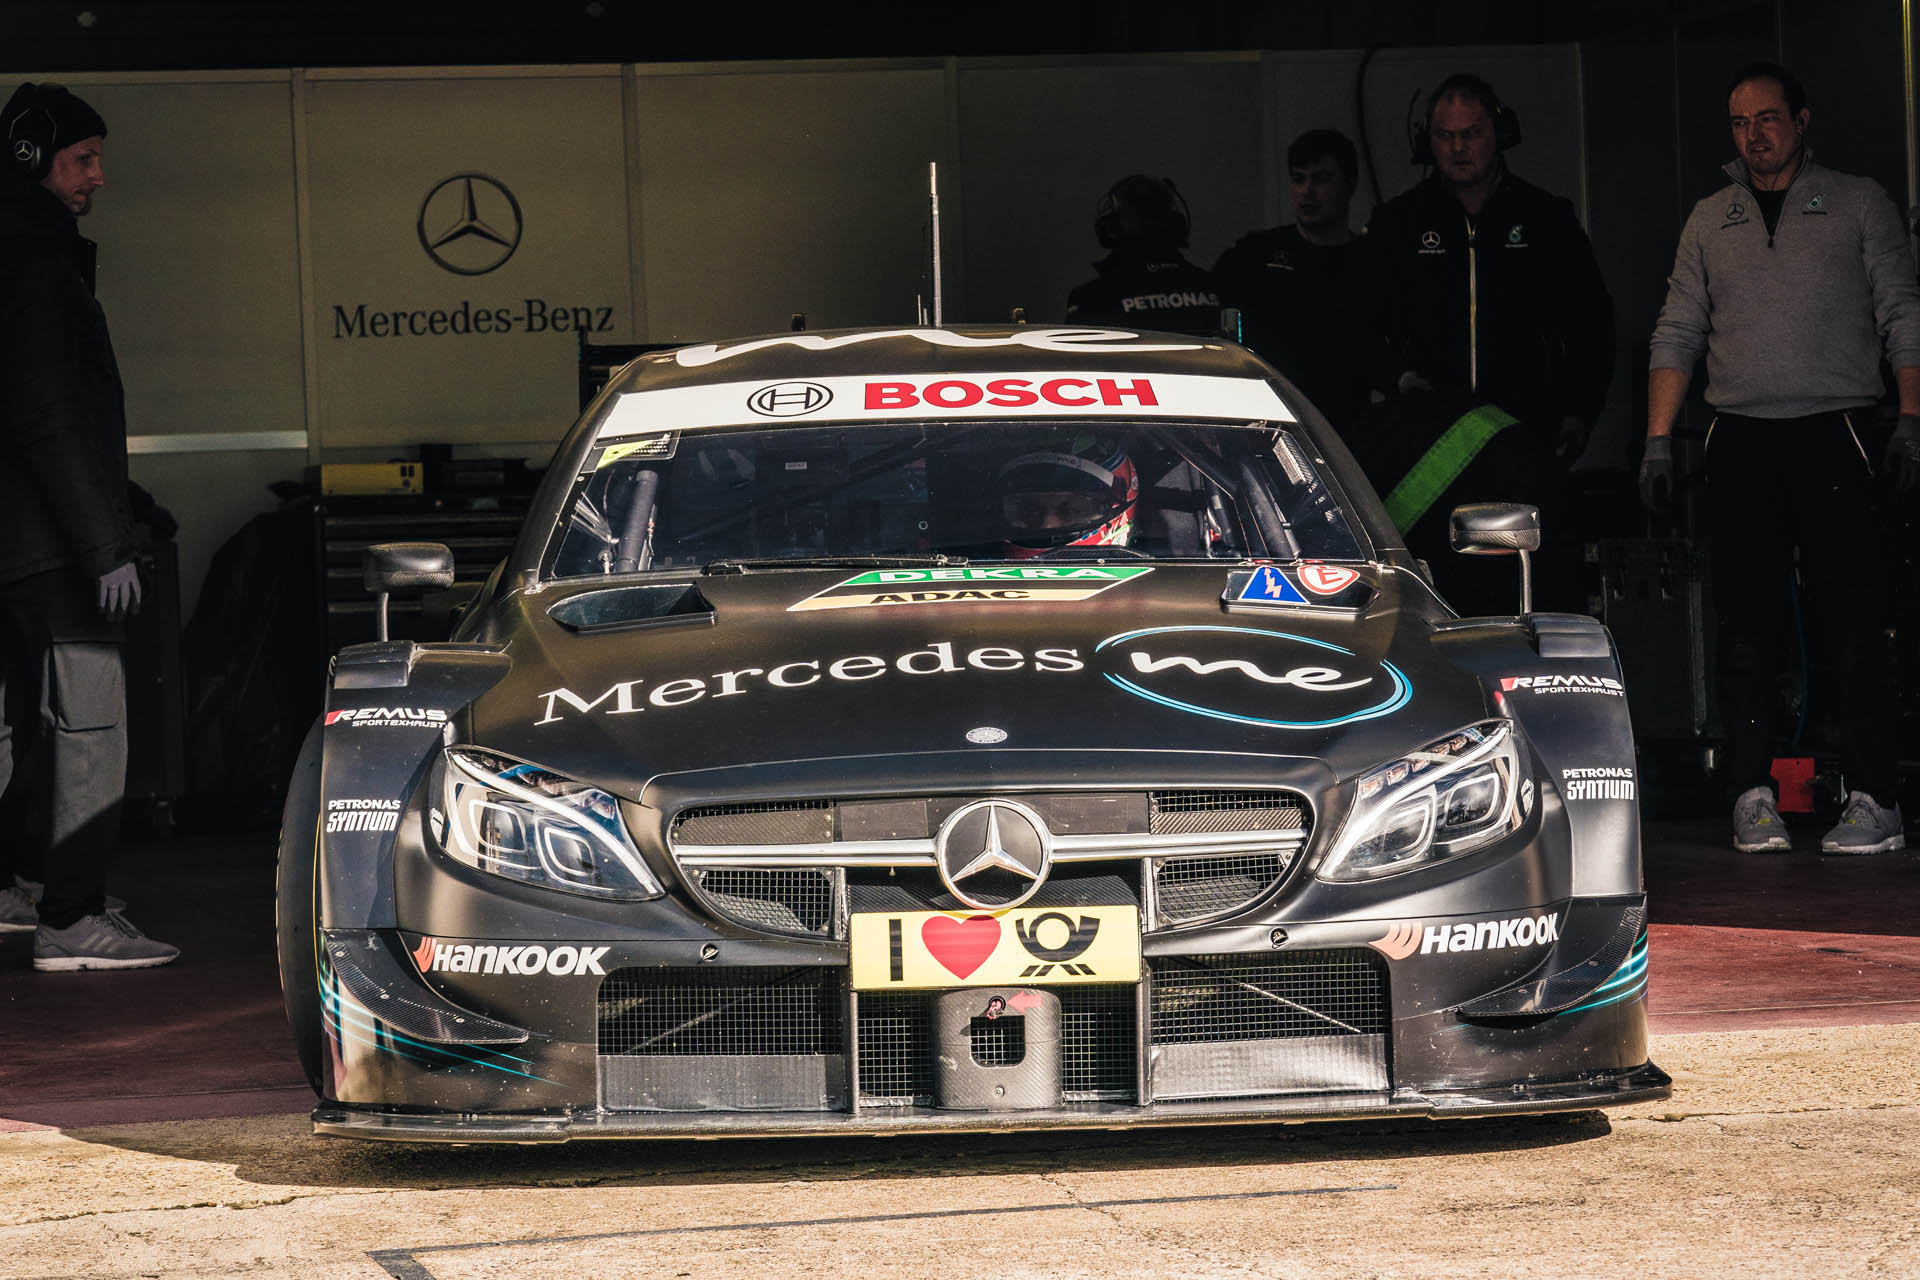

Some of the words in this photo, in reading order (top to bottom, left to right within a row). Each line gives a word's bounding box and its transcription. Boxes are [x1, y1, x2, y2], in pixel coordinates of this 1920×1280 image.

[1121, 291, 1220, 312] PETRONAS
[333, 299, 614, 338] Mercedes-Benz
[864, 377, 1159, 411] BOSCH
[879, 568, 1109, 583] DEKRA
[870, 589, 1030, 604] ADAC
[534, 641, 1085, 726] Mercedes
[1131, 647, 1374, 693] me
[1511, 674, 1623, 690] REMUS
[1534, 686, 1625, 697] SPORTEXHAUST
[332, 707, 448, 721] REMUS
[351, 719, 447, 729] SPORTEXHAUST
[1562, 767, 1633, 779] PETRONAS
[328, 799, 401, 811] PETRONAS
